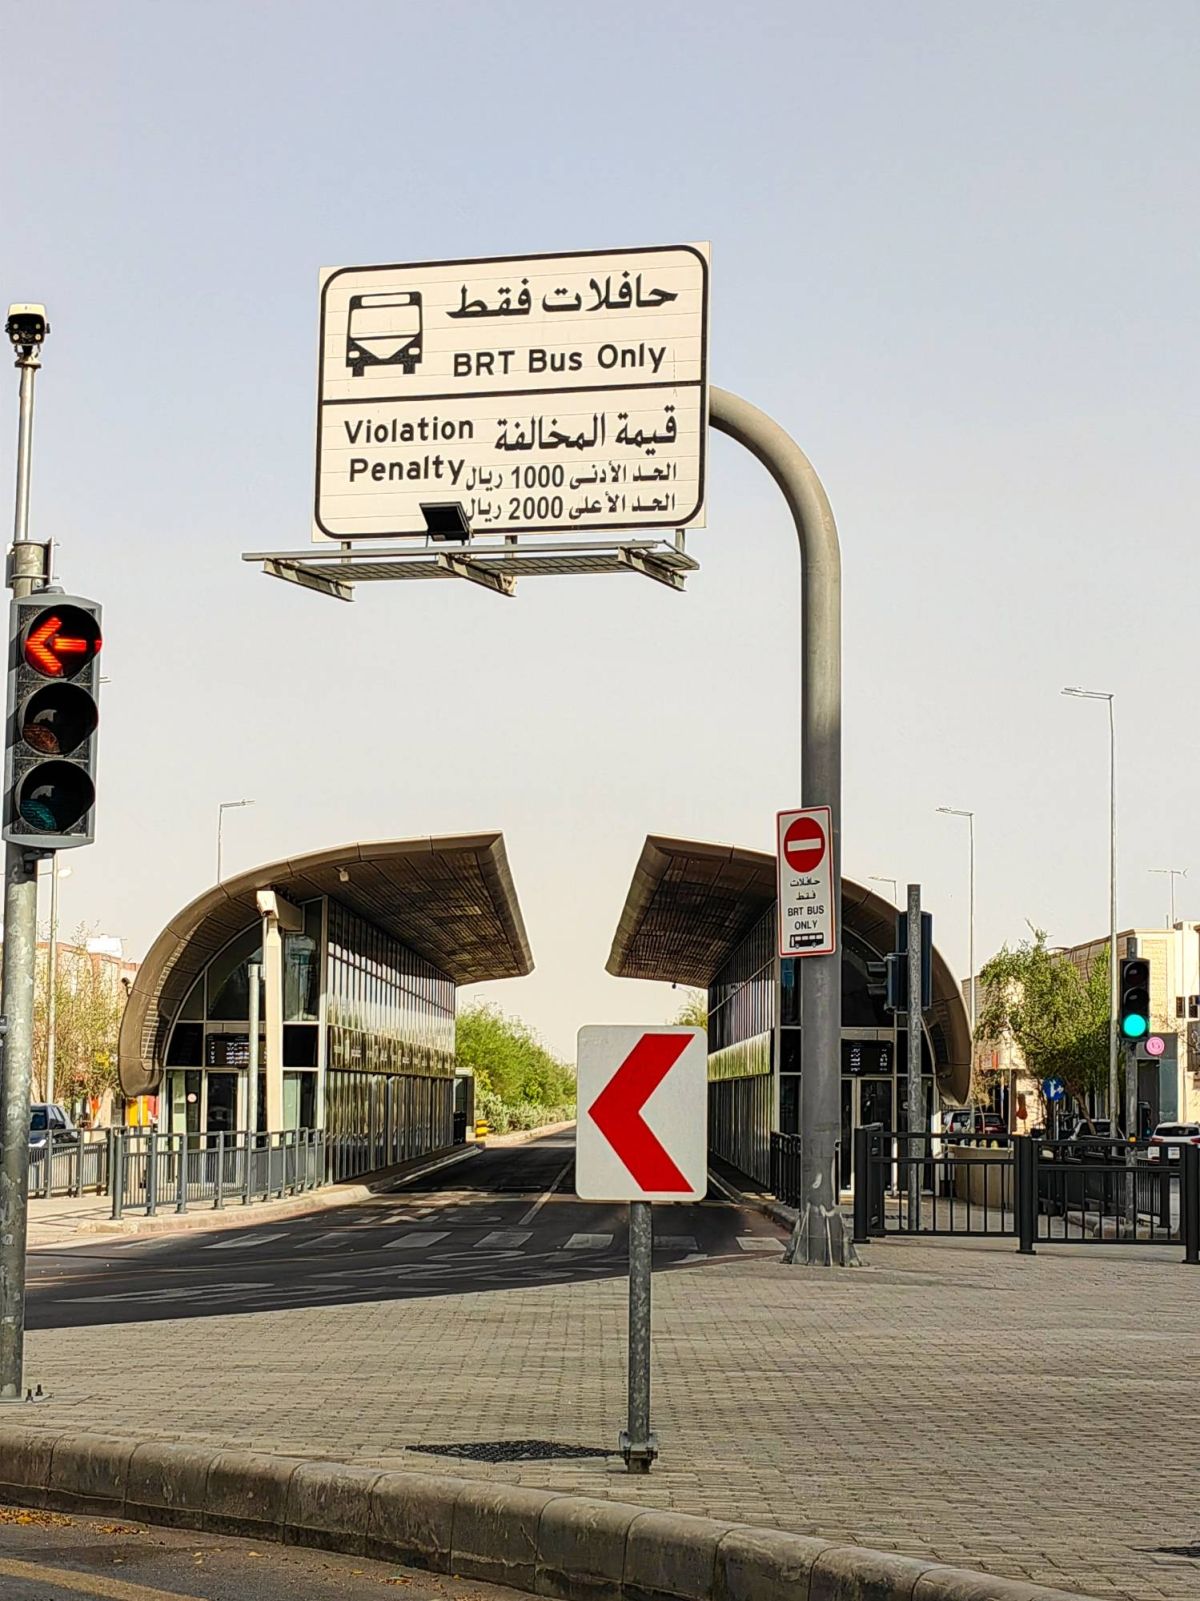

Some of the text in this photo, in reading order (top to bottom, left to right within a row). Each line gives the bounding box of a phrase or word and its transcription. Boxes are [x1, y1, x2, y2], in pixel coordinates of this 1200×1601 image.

[445, 270, 679, 319] حافلات فقط
[453, 342, 667, 378] BRT Bus Only
[344, 416, 474, 444] Violation
[494, 404, 677, 456] قيمة المخالفة
[349, 454, 466, 486] Penalty
[466, 460, 676, 491] الحد الأدنى 1000 ريال
[465, 490, 675, 523] الحد الأعلى 2000 ريال
[787, 905, 825, 917] BRT BUS
[794, 920, 818, 930] ONLY
